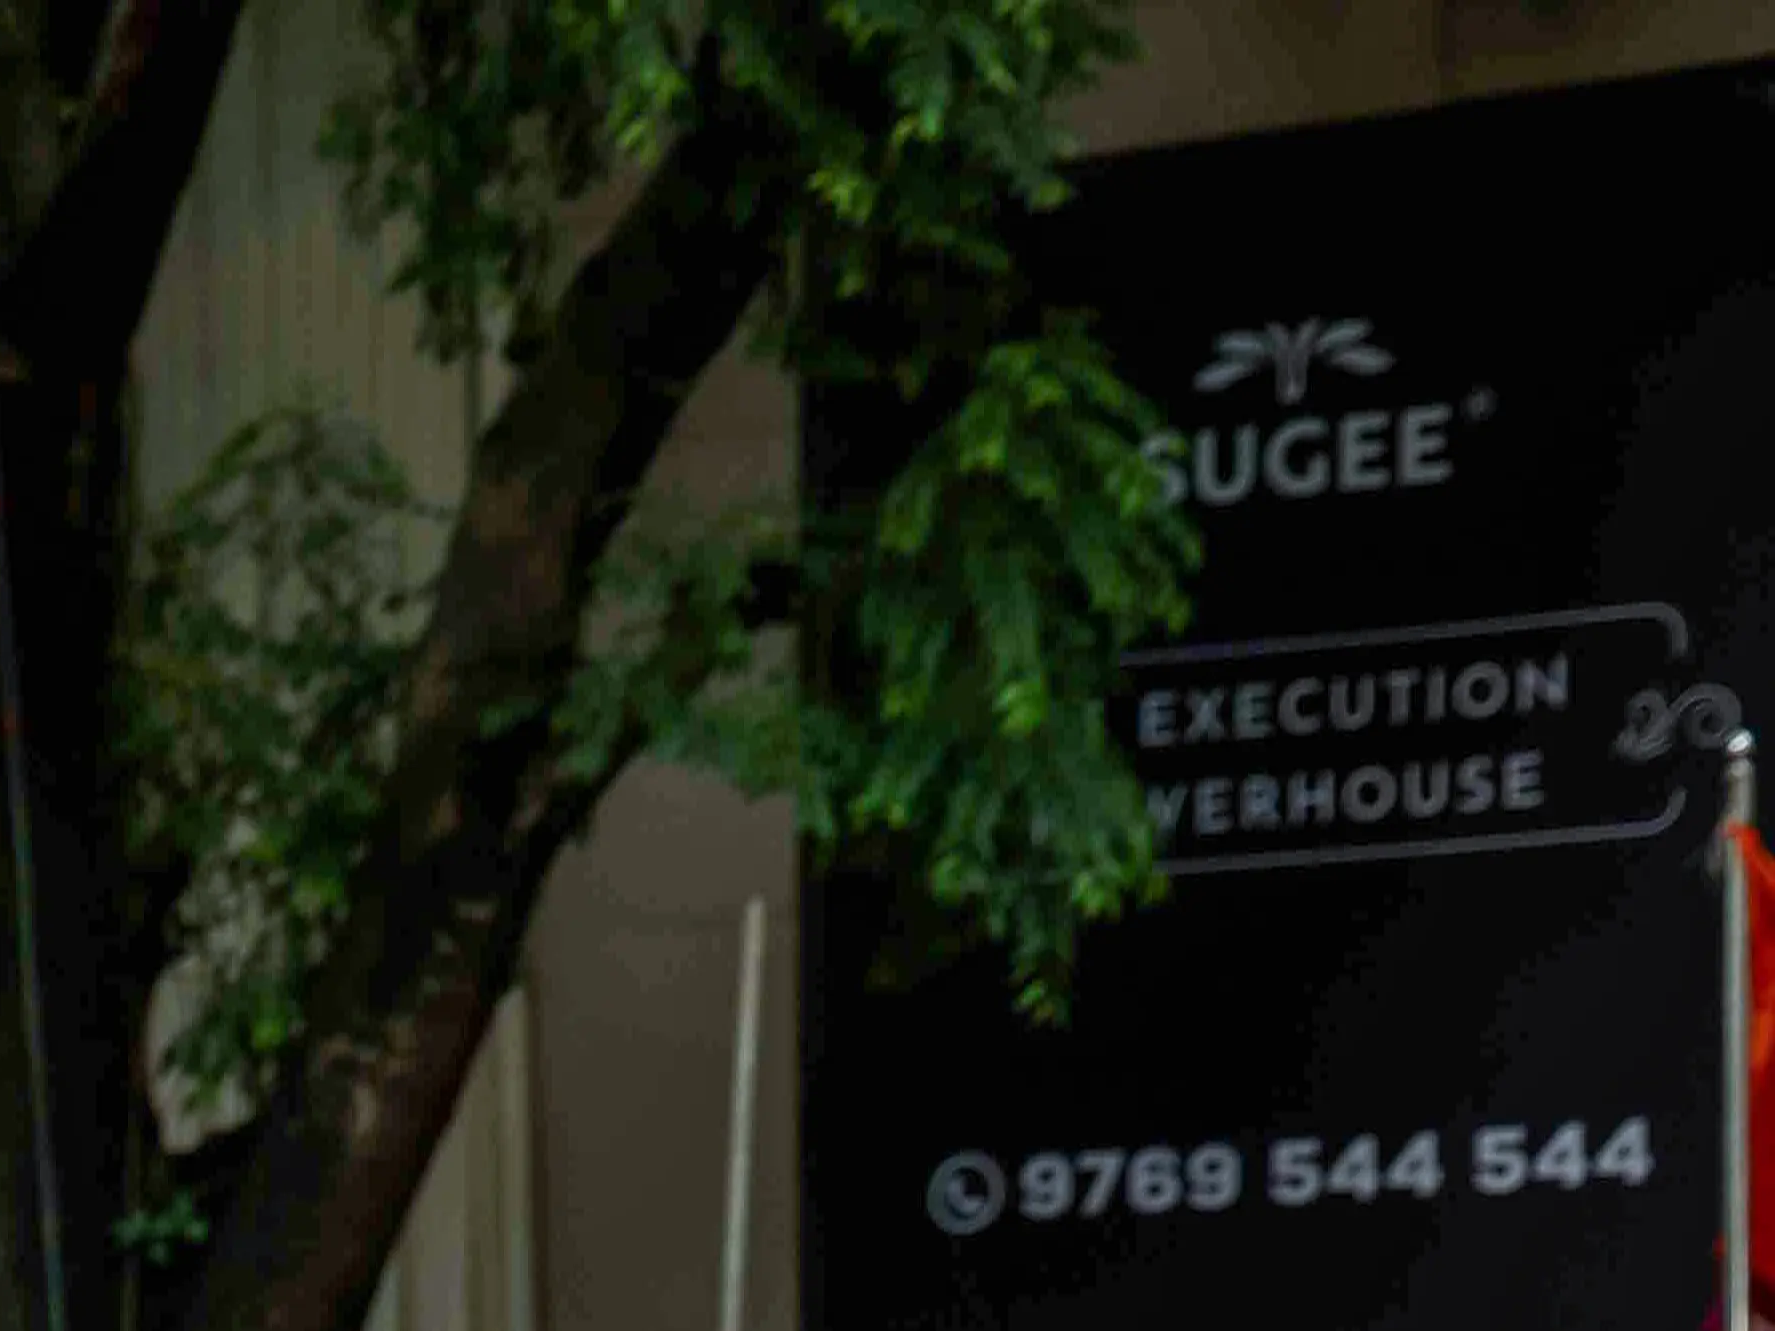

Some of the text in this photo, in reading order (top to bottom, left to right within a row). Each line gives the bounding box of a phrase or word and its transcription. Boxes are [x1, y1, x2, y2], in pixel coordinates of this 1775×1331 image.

[1140, 402, 1453, 508] SUGEE
[1137, 654, 1570, 748] EXECUTION
[1017, 1116, 1654, 1222] 9769 544 544
